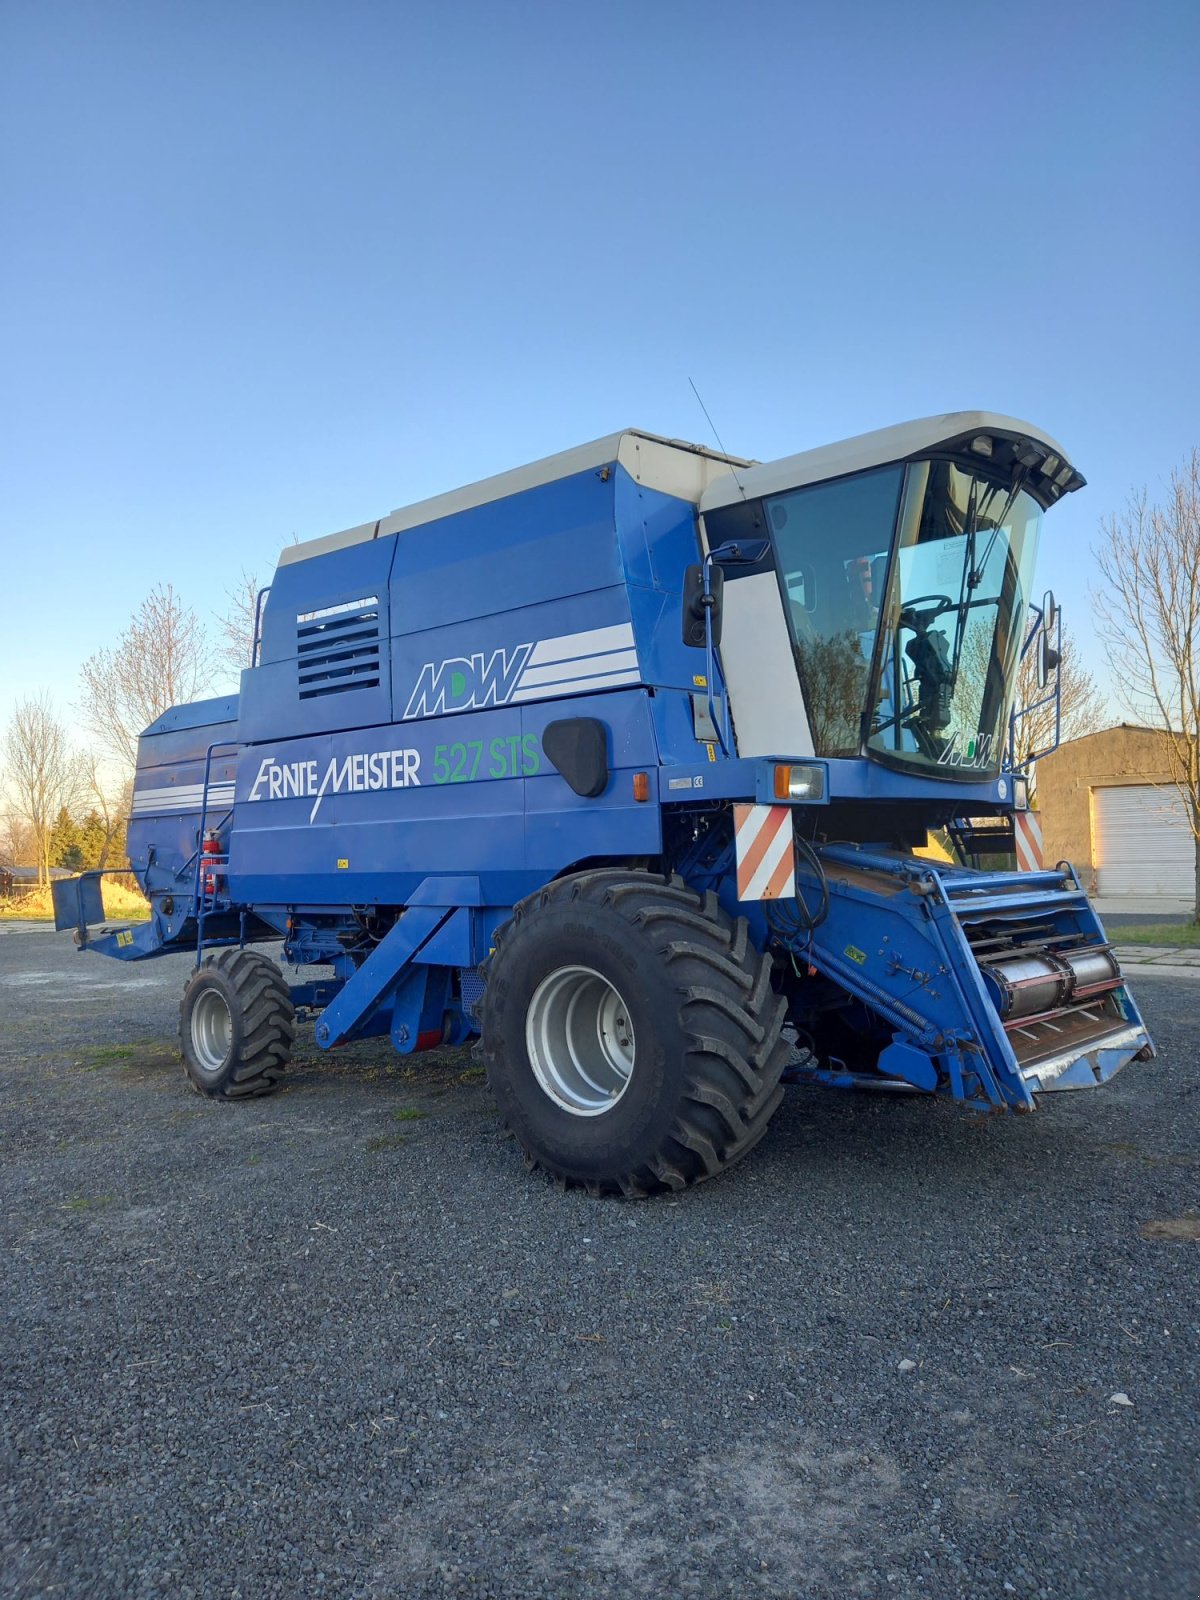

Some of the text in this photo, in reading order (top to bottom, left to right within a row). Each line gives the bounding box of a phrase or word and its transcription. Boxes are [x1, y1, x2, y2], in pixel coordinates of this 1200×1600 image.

[403, 643, 534, 719] MDW
[248, 734, 540, 822] ERNTE MEISTER 527 STS
